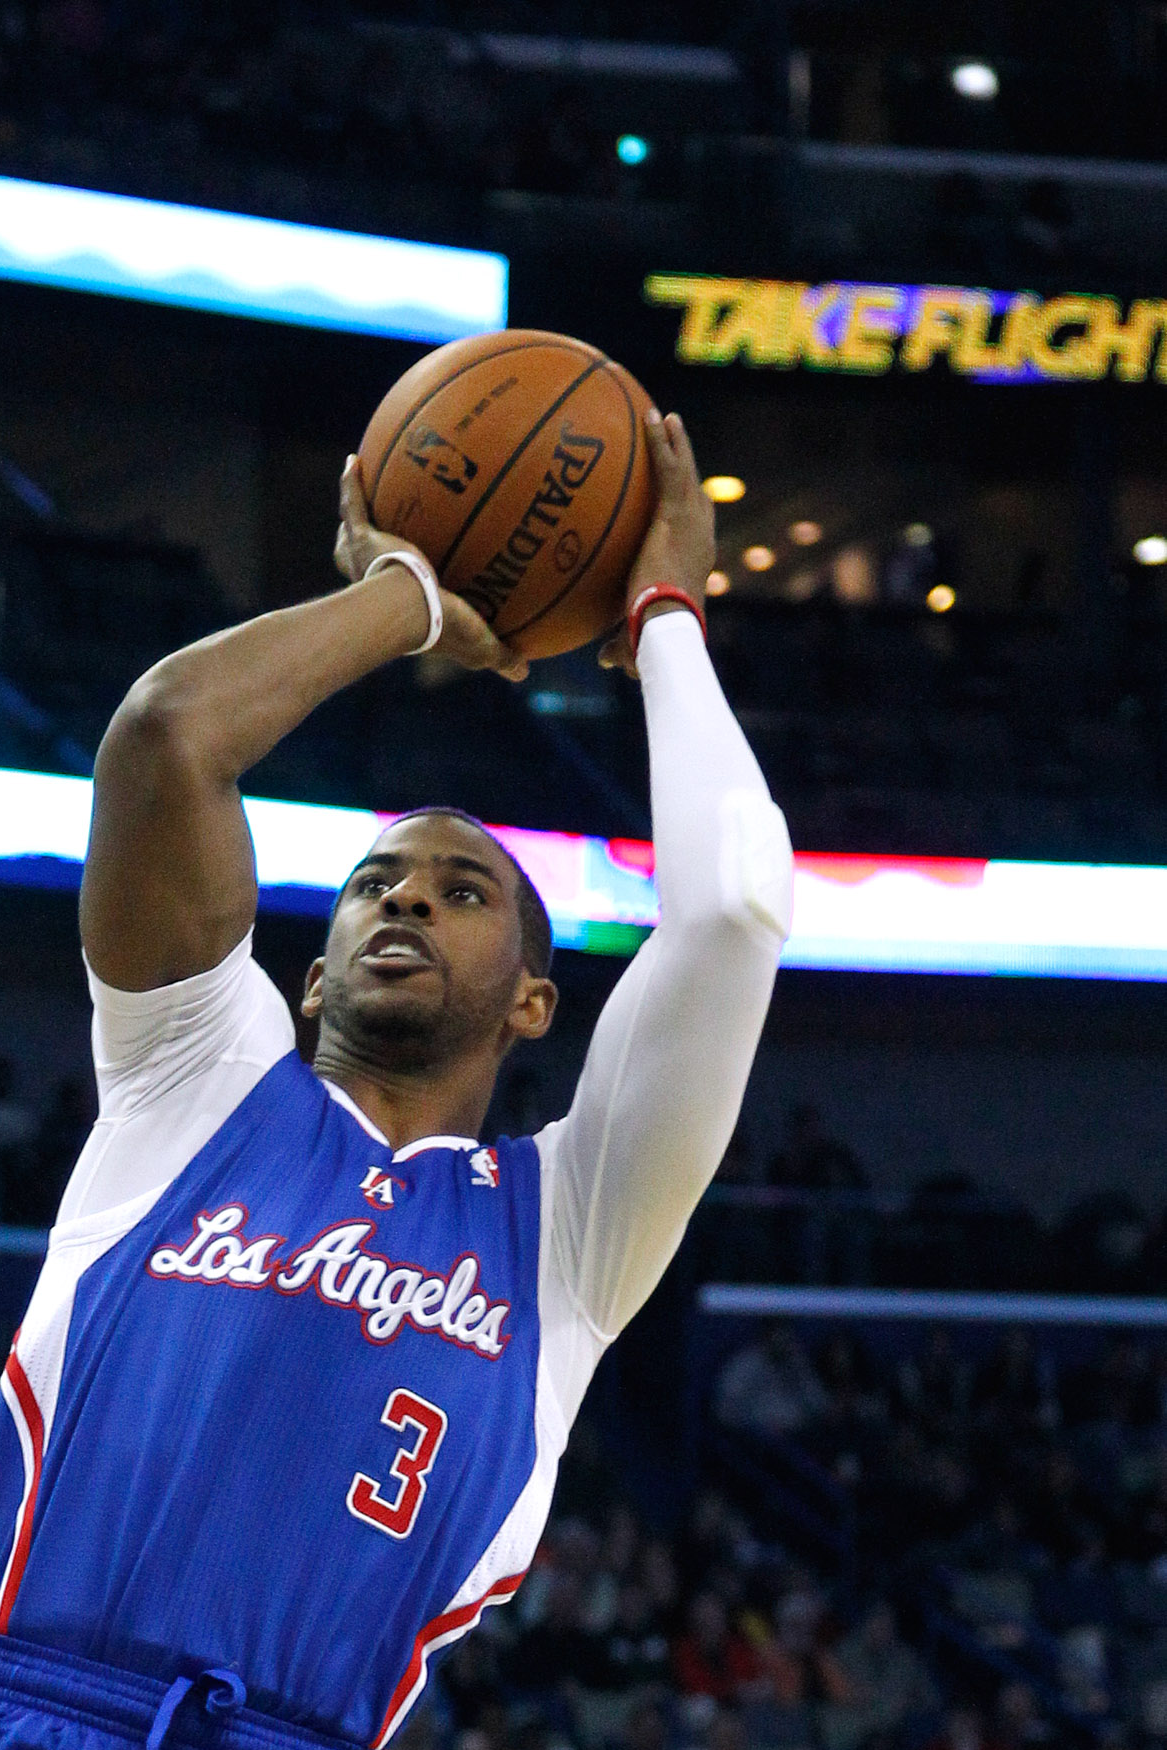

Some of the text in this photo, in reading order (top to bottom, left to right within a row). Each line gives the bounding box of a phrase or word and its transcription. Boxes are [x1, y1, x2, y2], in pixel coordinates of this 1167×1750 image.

[643, 271, 902, 376] TAKE
[147, 1202, 512, 1361] Los Angeles
[346, 1387, 448, 1540] 3
